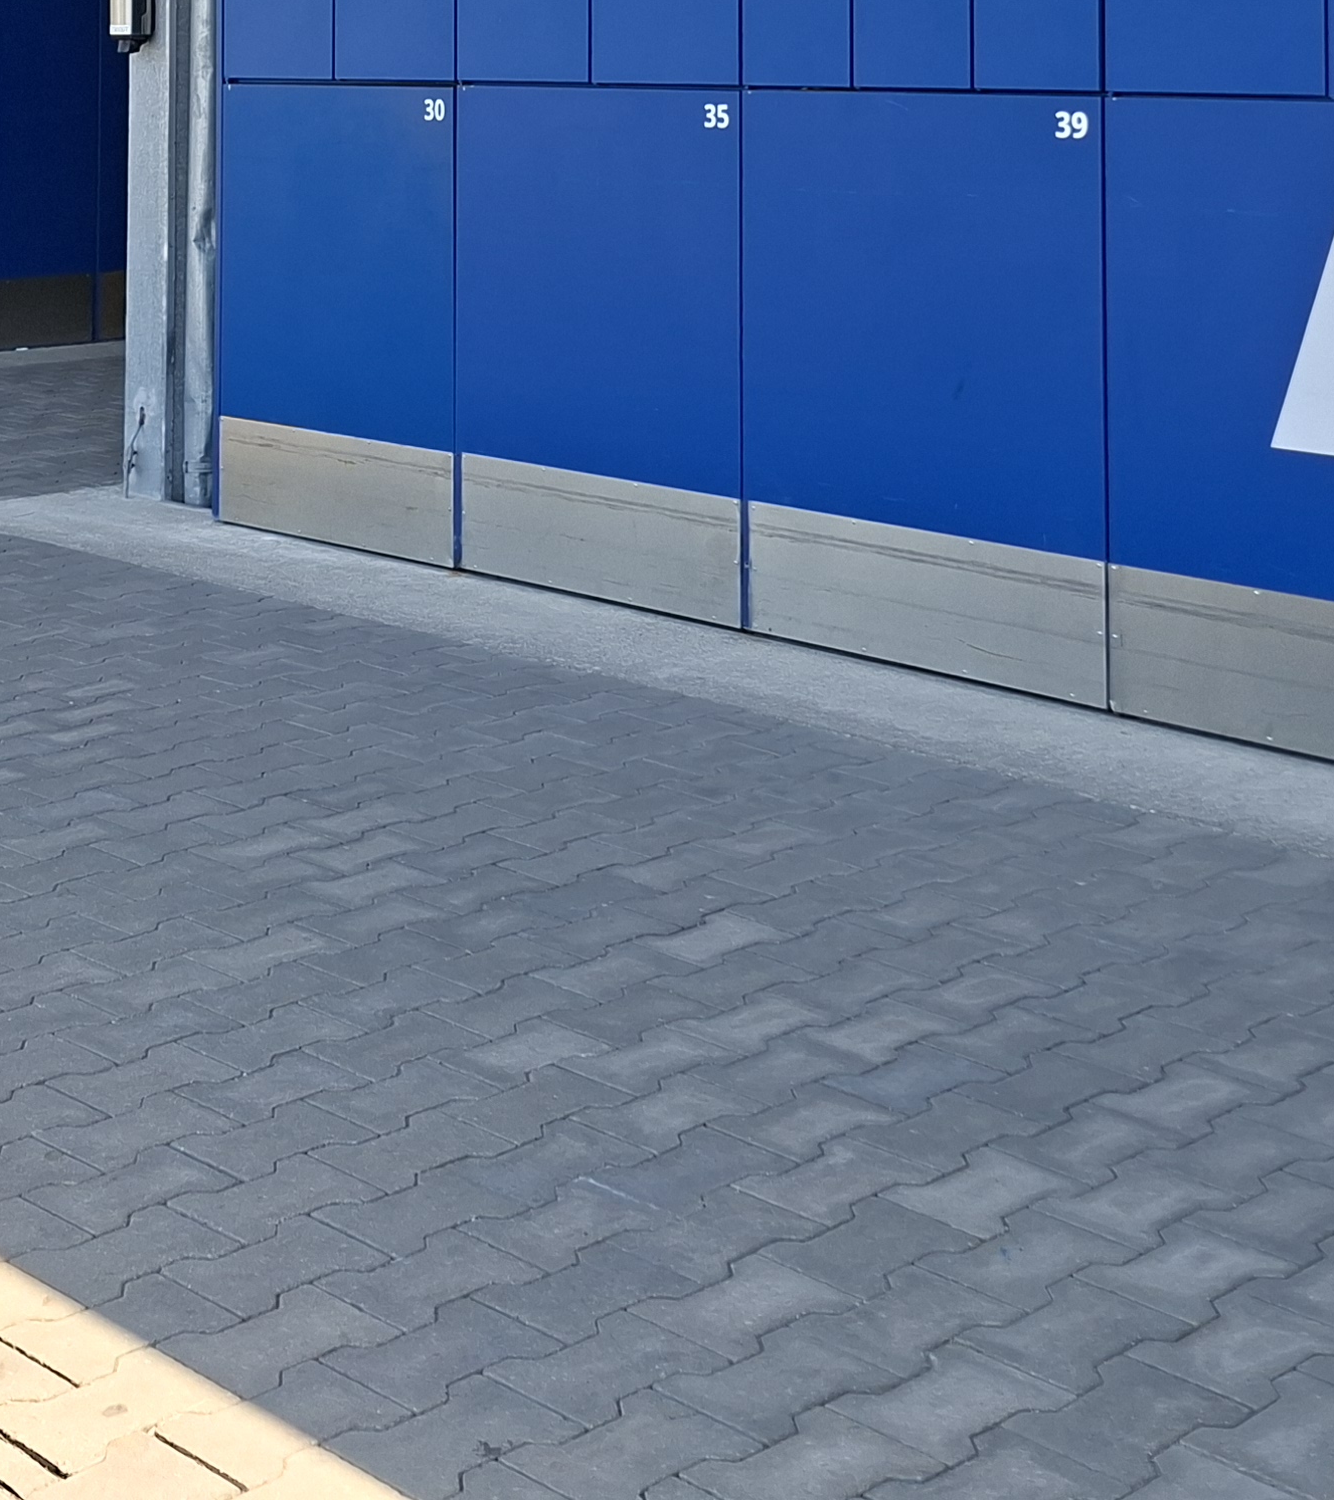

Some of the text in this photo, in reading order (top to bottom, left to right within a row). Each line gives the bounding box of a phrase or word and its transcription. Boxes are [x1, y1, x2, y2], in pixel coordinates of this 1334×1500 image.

[425, 99, 444, 120] 30
[704, 104, 729, 128] 35
[1056, 111, 1088, 138] 39
